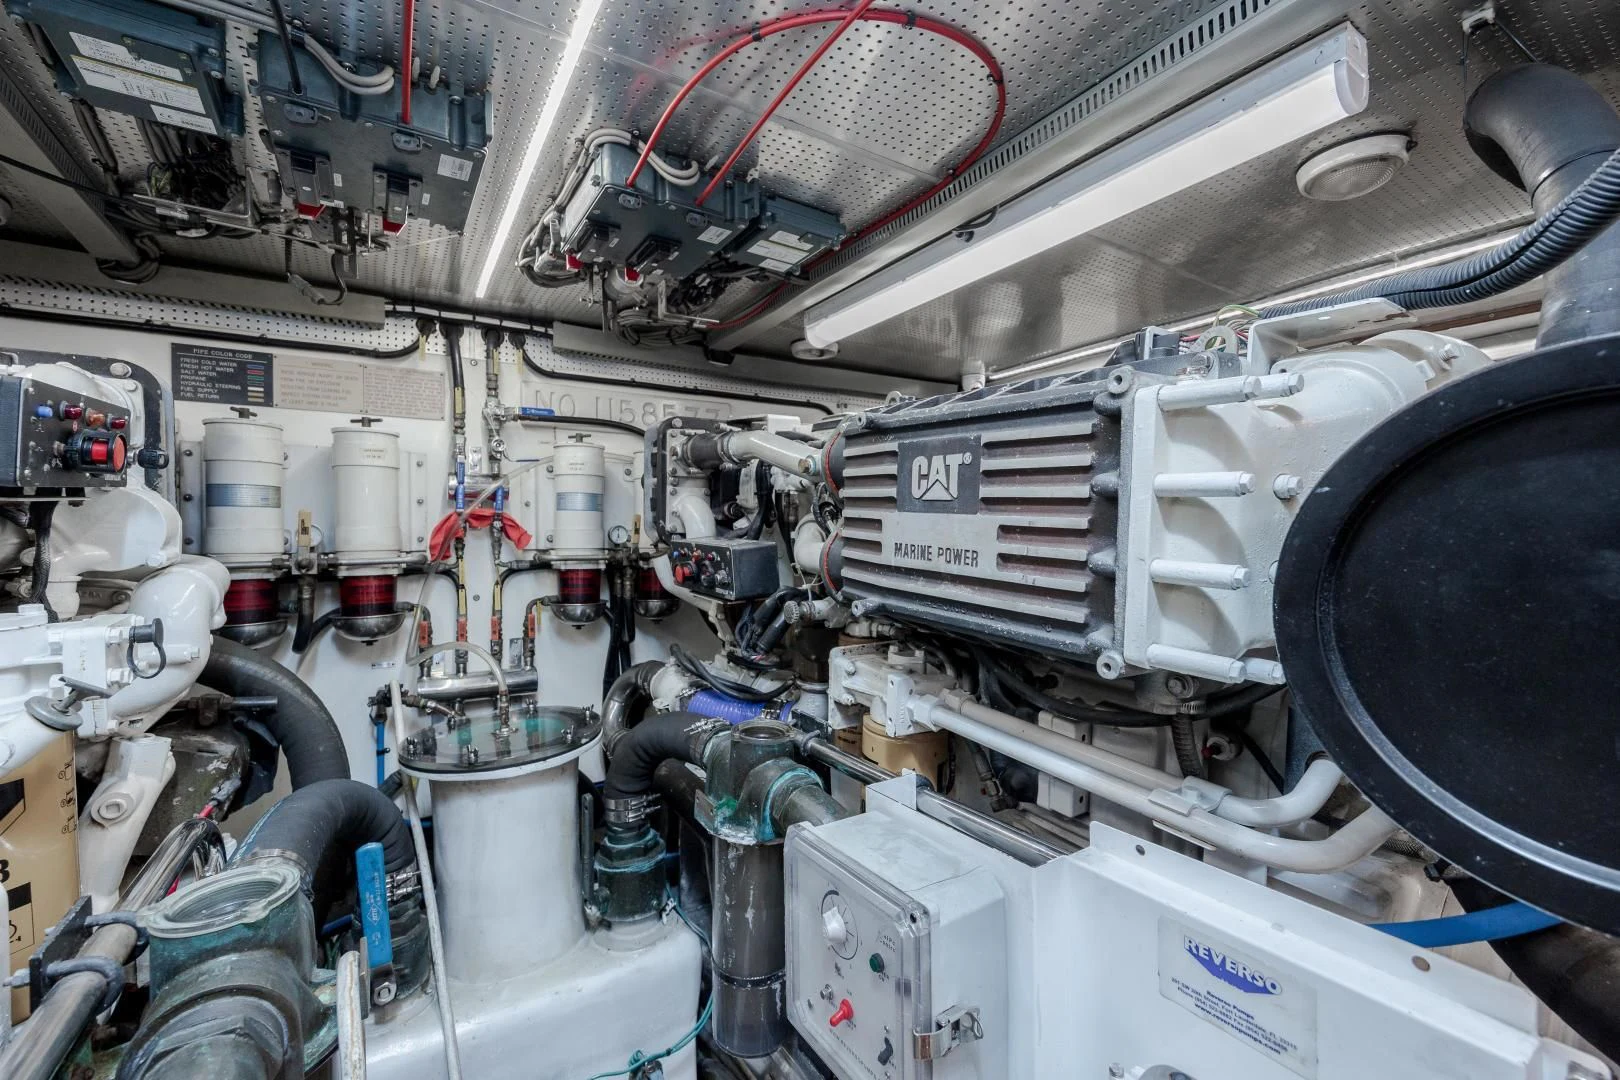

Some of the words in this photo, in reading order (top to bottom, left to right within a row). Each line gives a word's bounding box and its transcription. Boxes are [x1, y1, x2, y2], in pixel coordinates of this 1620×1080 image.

[911, 453, 964, 500] CAT
[894, 542, 932, 562] MARINE
[937, 546, 979, 568] POWER
[1184, 934, 1283, 996] REVERSO
[1206, 990, 1231, 1008] Reverso
[1232, 1004, 1255, 1020] Pumps
